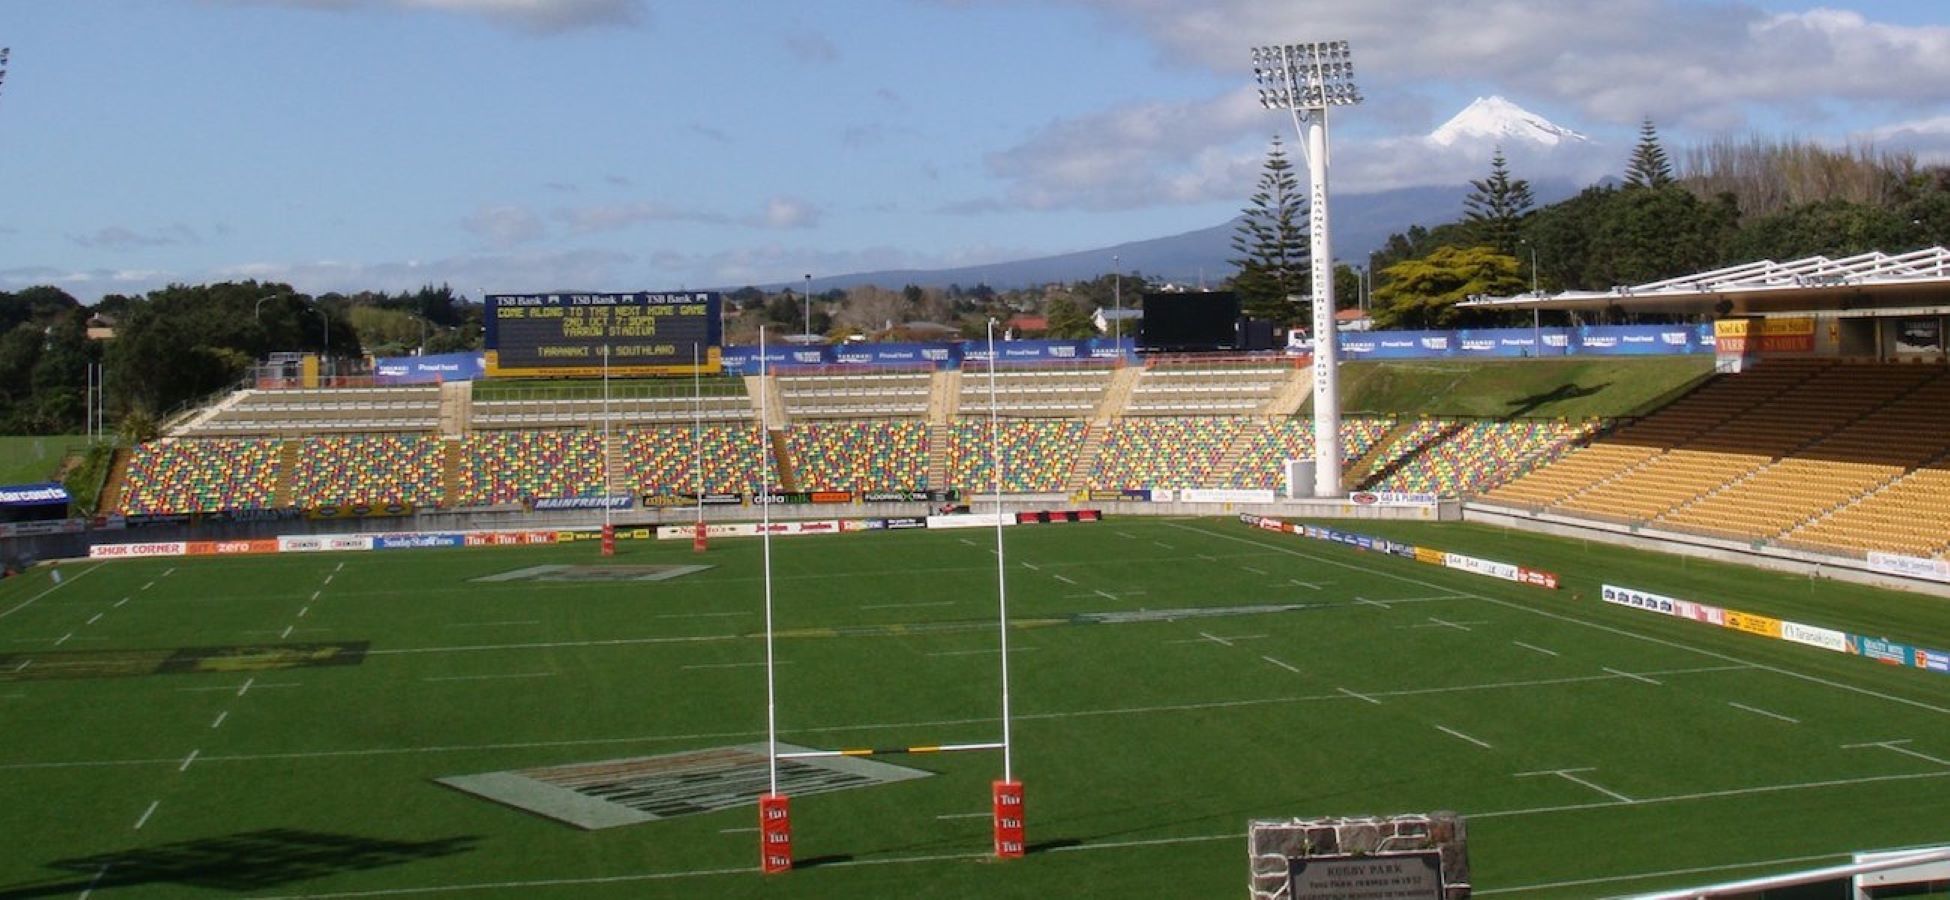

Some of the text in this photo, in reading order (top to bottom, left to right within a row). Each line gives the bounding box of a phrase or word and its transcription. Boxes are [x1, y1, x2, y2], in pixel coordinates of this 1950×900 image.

[496, 296, 543, 306] TSB Bank
[572, 295, 616, 305] TSB Bank
[646, 294, 692, 304] TSB Bank
[498, 305, 706, 318] COME ALONG TO THE NEXT HOME GAME
[589, 318, 606, 327] OCT
[563, 326, 655, 337] YARROW STADIUM
[538, 347, 589, 357] TARANAKI
[616, 346, 674, 356] SOUTHLAND
[418, 363, 439, 371] Proud
[536, 496, 630, 509] MAINFREIGHT
[132, 543, 179, 554] CORNER
[217, 541, 249, 553] zero
[998, 795, 1021, 806] Tui
[1000, 819, 1022, 829] Tui
[1002, 842, 1022, 852] Tui
[769, 856, 790, 866] Tui
[1370, 864, 1402, 876] PARK
